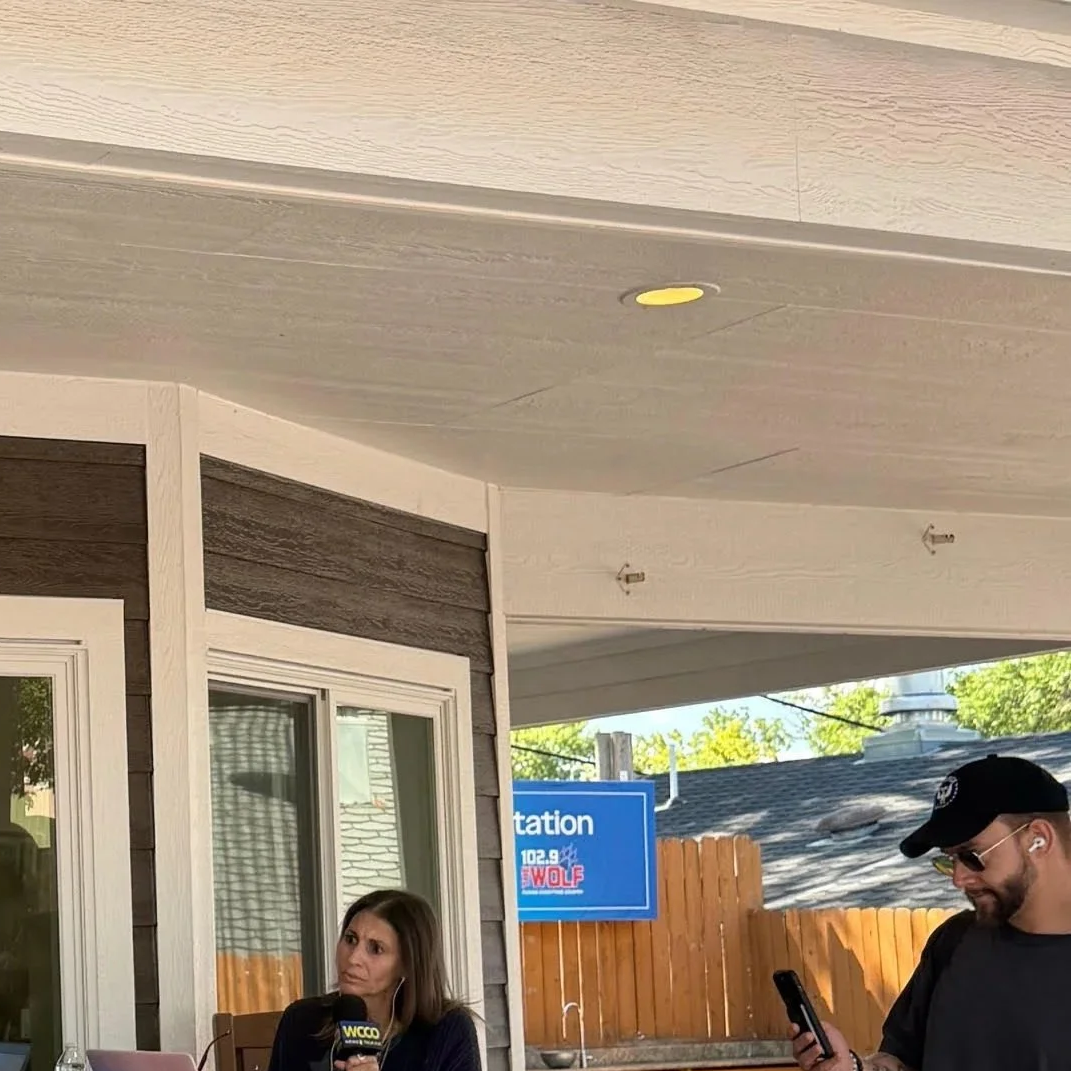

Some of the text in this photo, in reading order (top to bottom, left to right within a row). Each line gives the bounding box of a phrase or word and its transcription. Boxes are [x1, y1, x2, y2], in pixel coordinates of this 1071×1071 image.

[513, 810, 594, 836] tation
[521, 849, 559, 865] 102.9
[530, 866, 584, 888] WOLF
[343, 1025, 380, 1039] WCCO
